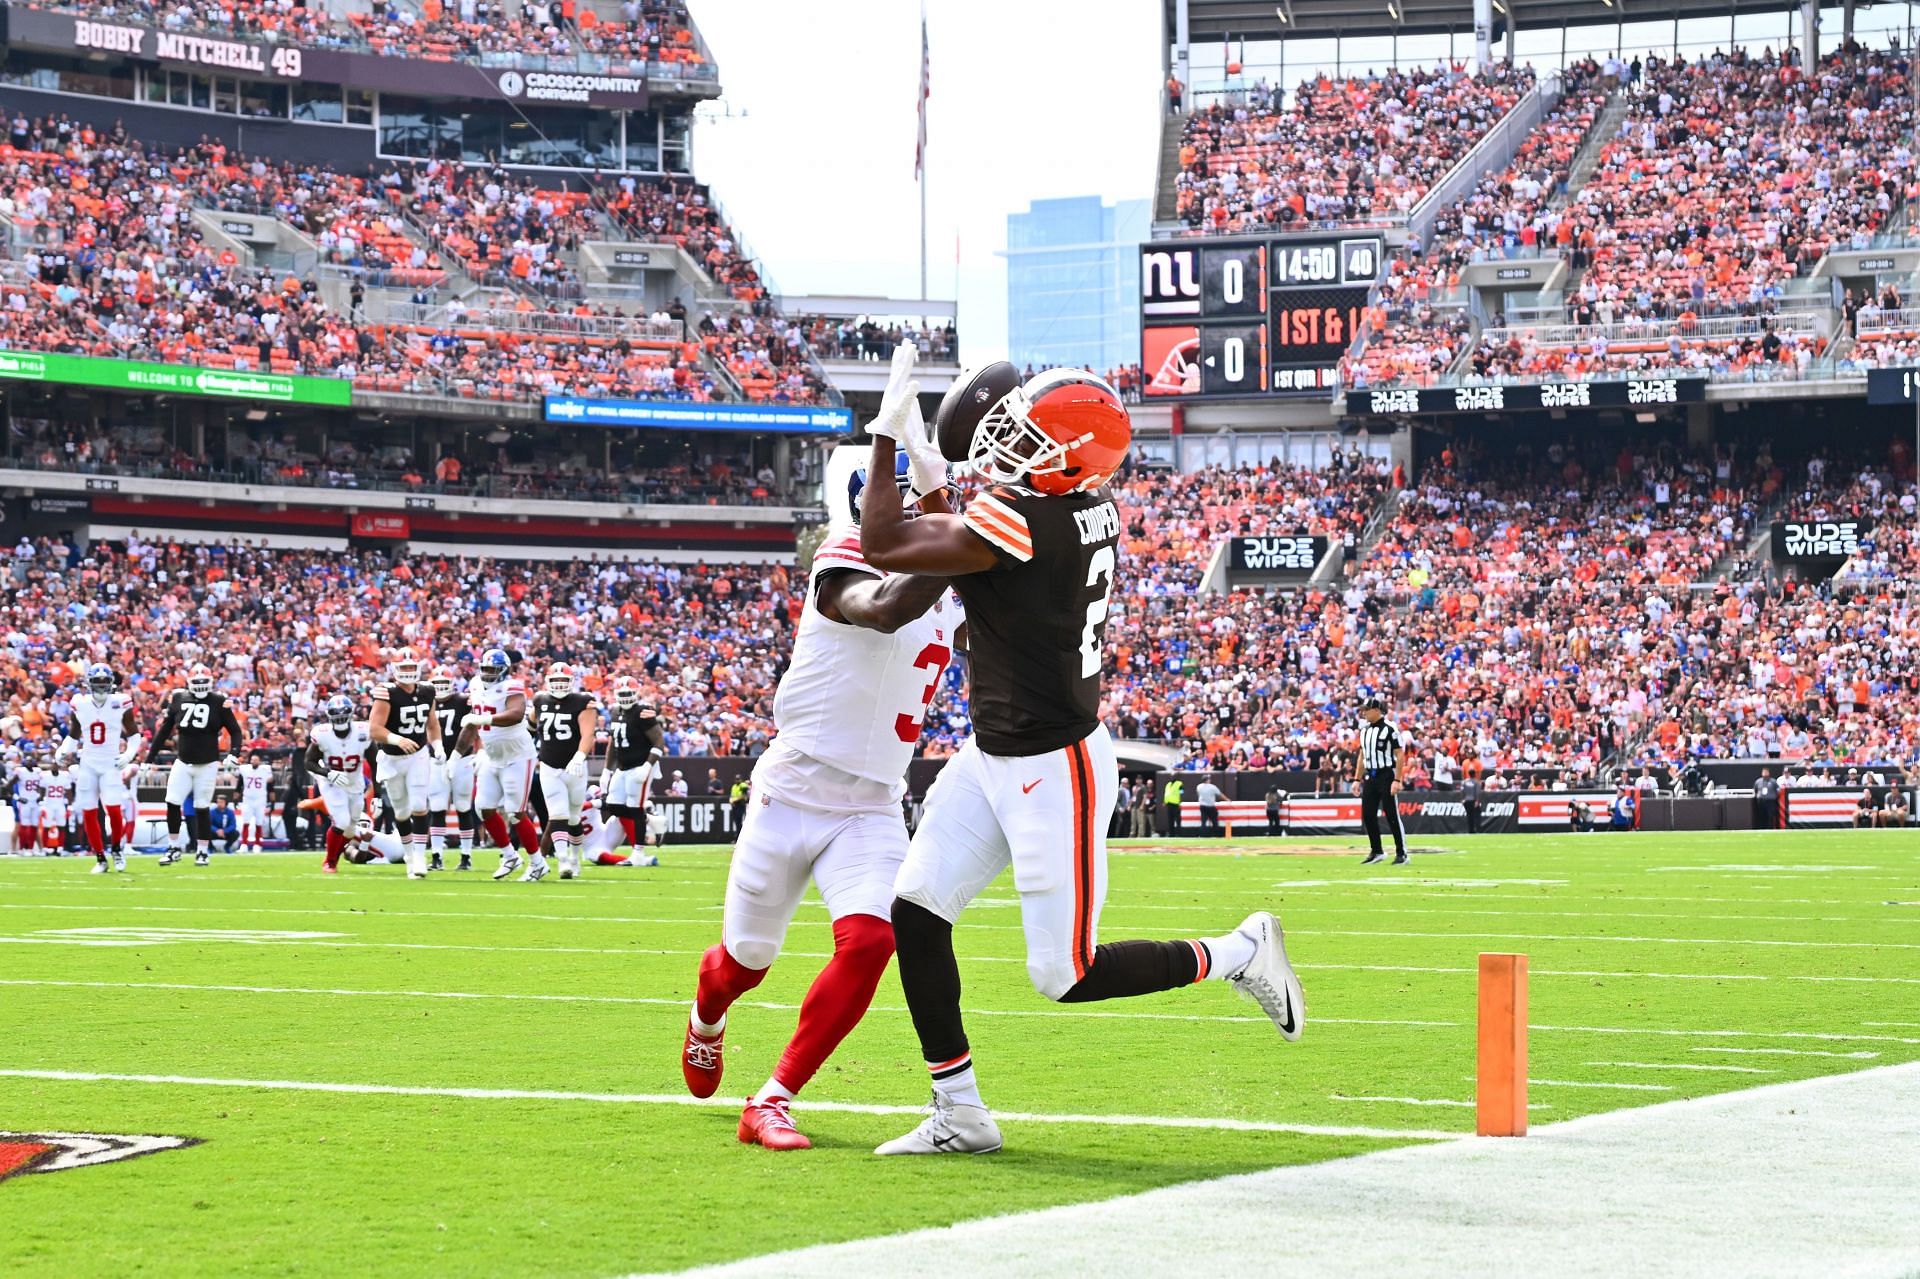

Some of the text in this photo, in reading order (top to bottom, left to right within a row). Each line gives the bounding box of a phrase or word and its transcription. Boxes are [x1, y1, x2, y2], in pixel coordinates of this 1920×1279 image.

[75, 20, 302, 77] BOBBY MITCHELL 49
[525, 73, 641, 93] CROSSCOUNTRY
[527, 88, 589, 102] MORTGAGE
[1279, 247, 1336, 281] 14:50
[1349, 249, 1371, 275] 40
[1223, 259, 1243, 304] 0
[1281, 307, 1321, 346] 1ST
[1324, 308, 1343, 344] &
[1224, 337, 1244, 382] 0
[127, 371, 177, 386] WELCOME
[180, 375, 193, 387] TO
[1628, 380, 1676, 393] DUDE
[1371, 390, 1418, 403] DUDE
[1455, 387, 1503, 400] DUDE
[1541, 384, 1590, 397] DUDE
[1541, 394, 1590, 407] WIPES
[1628, 390, 1677, 403] WIPES
[1371, 400, 1419, 413] WIPES
[1456, 397, 1504, 410] WIPES
[1073, 501, 1120, 545] COOPER
[1785, 522, 1858, 542] DUDE
[1244, 537, 1314, 555] DUDE
[1785, 540, 1858, 555] WIPES
[1244, 555, 1314, 568] WIPES
[1079, 546, 1115, 679] 2
[895, 643, 950, 742] 3
[180, 703, 210, 728] 79
[399, 704, 430, 734] 55
[90, 722, 106, 744] 0
[540, 712, 572, 741] 75
[611, 722, 630, 747] 71
[328, 755, 360, 772] 93
[48, 786, 64, 798] 29
[247, 777, 261, 788] 76
[691, 804, 715, 832] OF
